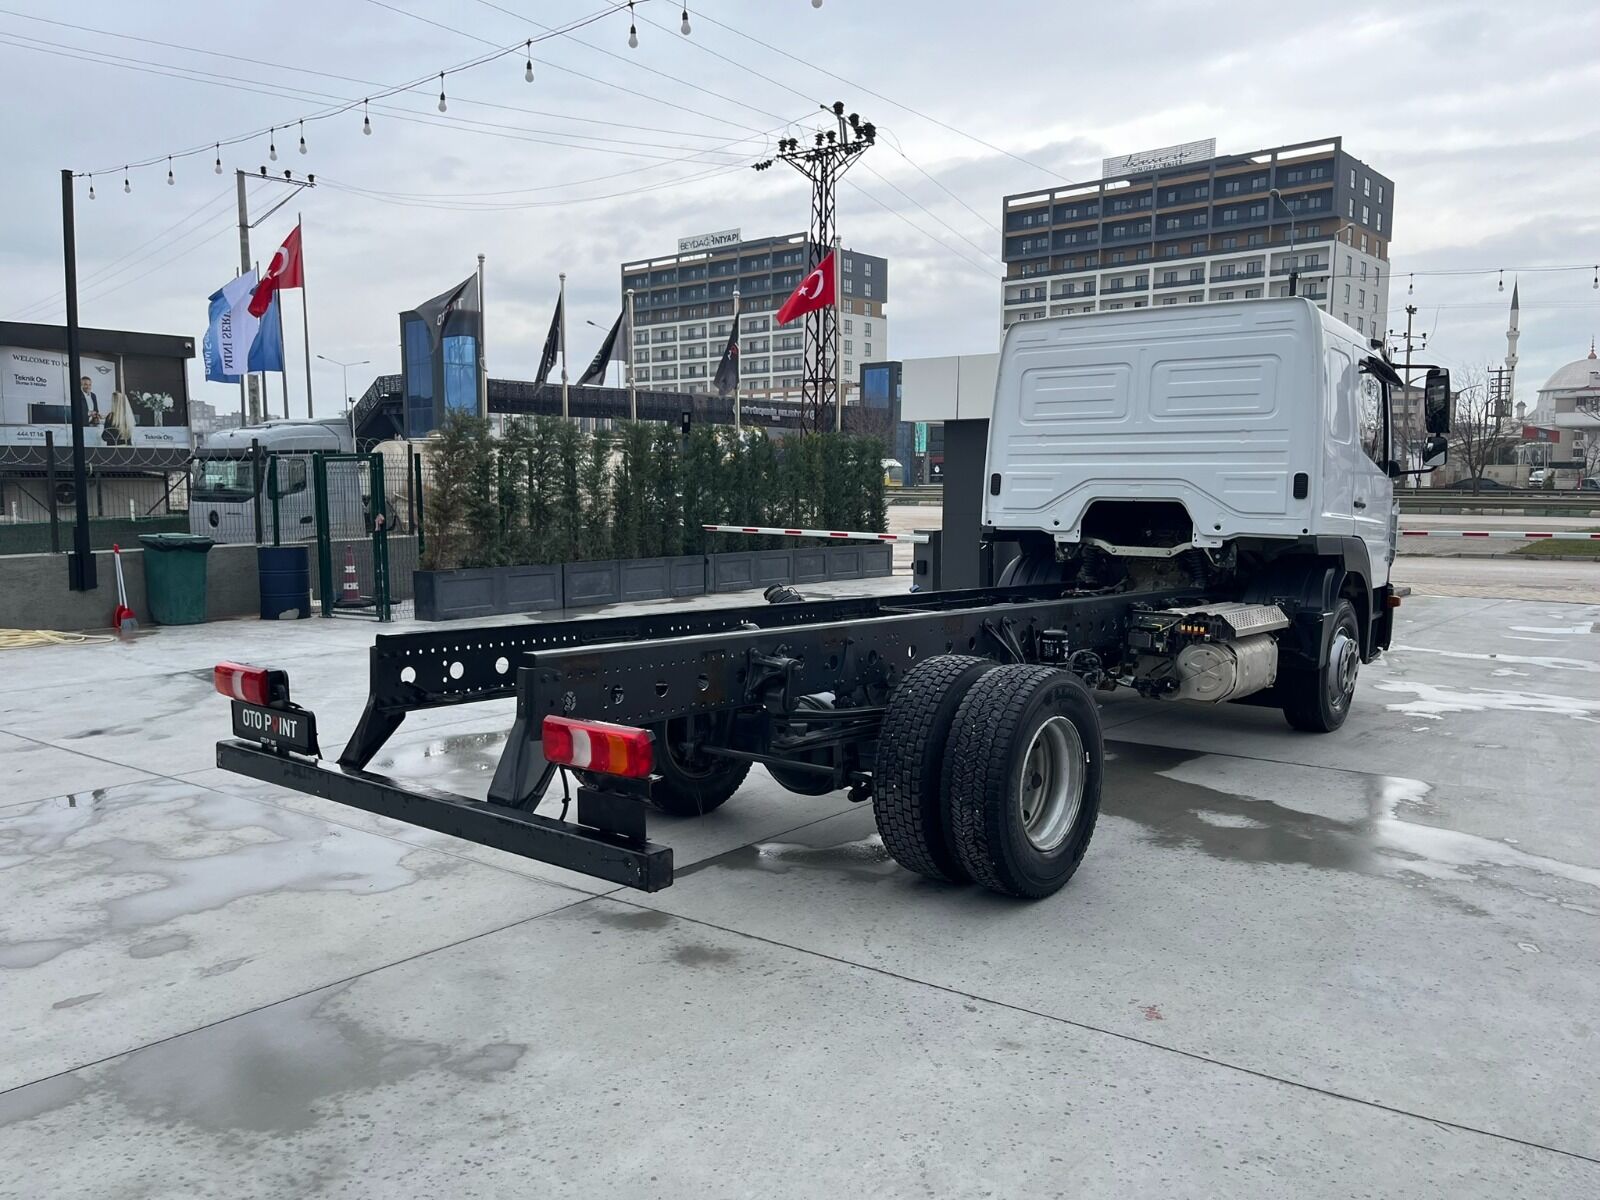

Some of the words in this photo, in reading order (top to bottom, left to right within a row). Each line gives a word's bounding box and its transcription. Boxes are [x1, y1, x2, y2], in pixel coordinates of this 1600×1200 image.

[12, 353, 50, 365] WELCOME
[51, 359, 61, 367] TO
[14, 374, 35, 382] Teknik
[242, 708, 262, 730] OTO
